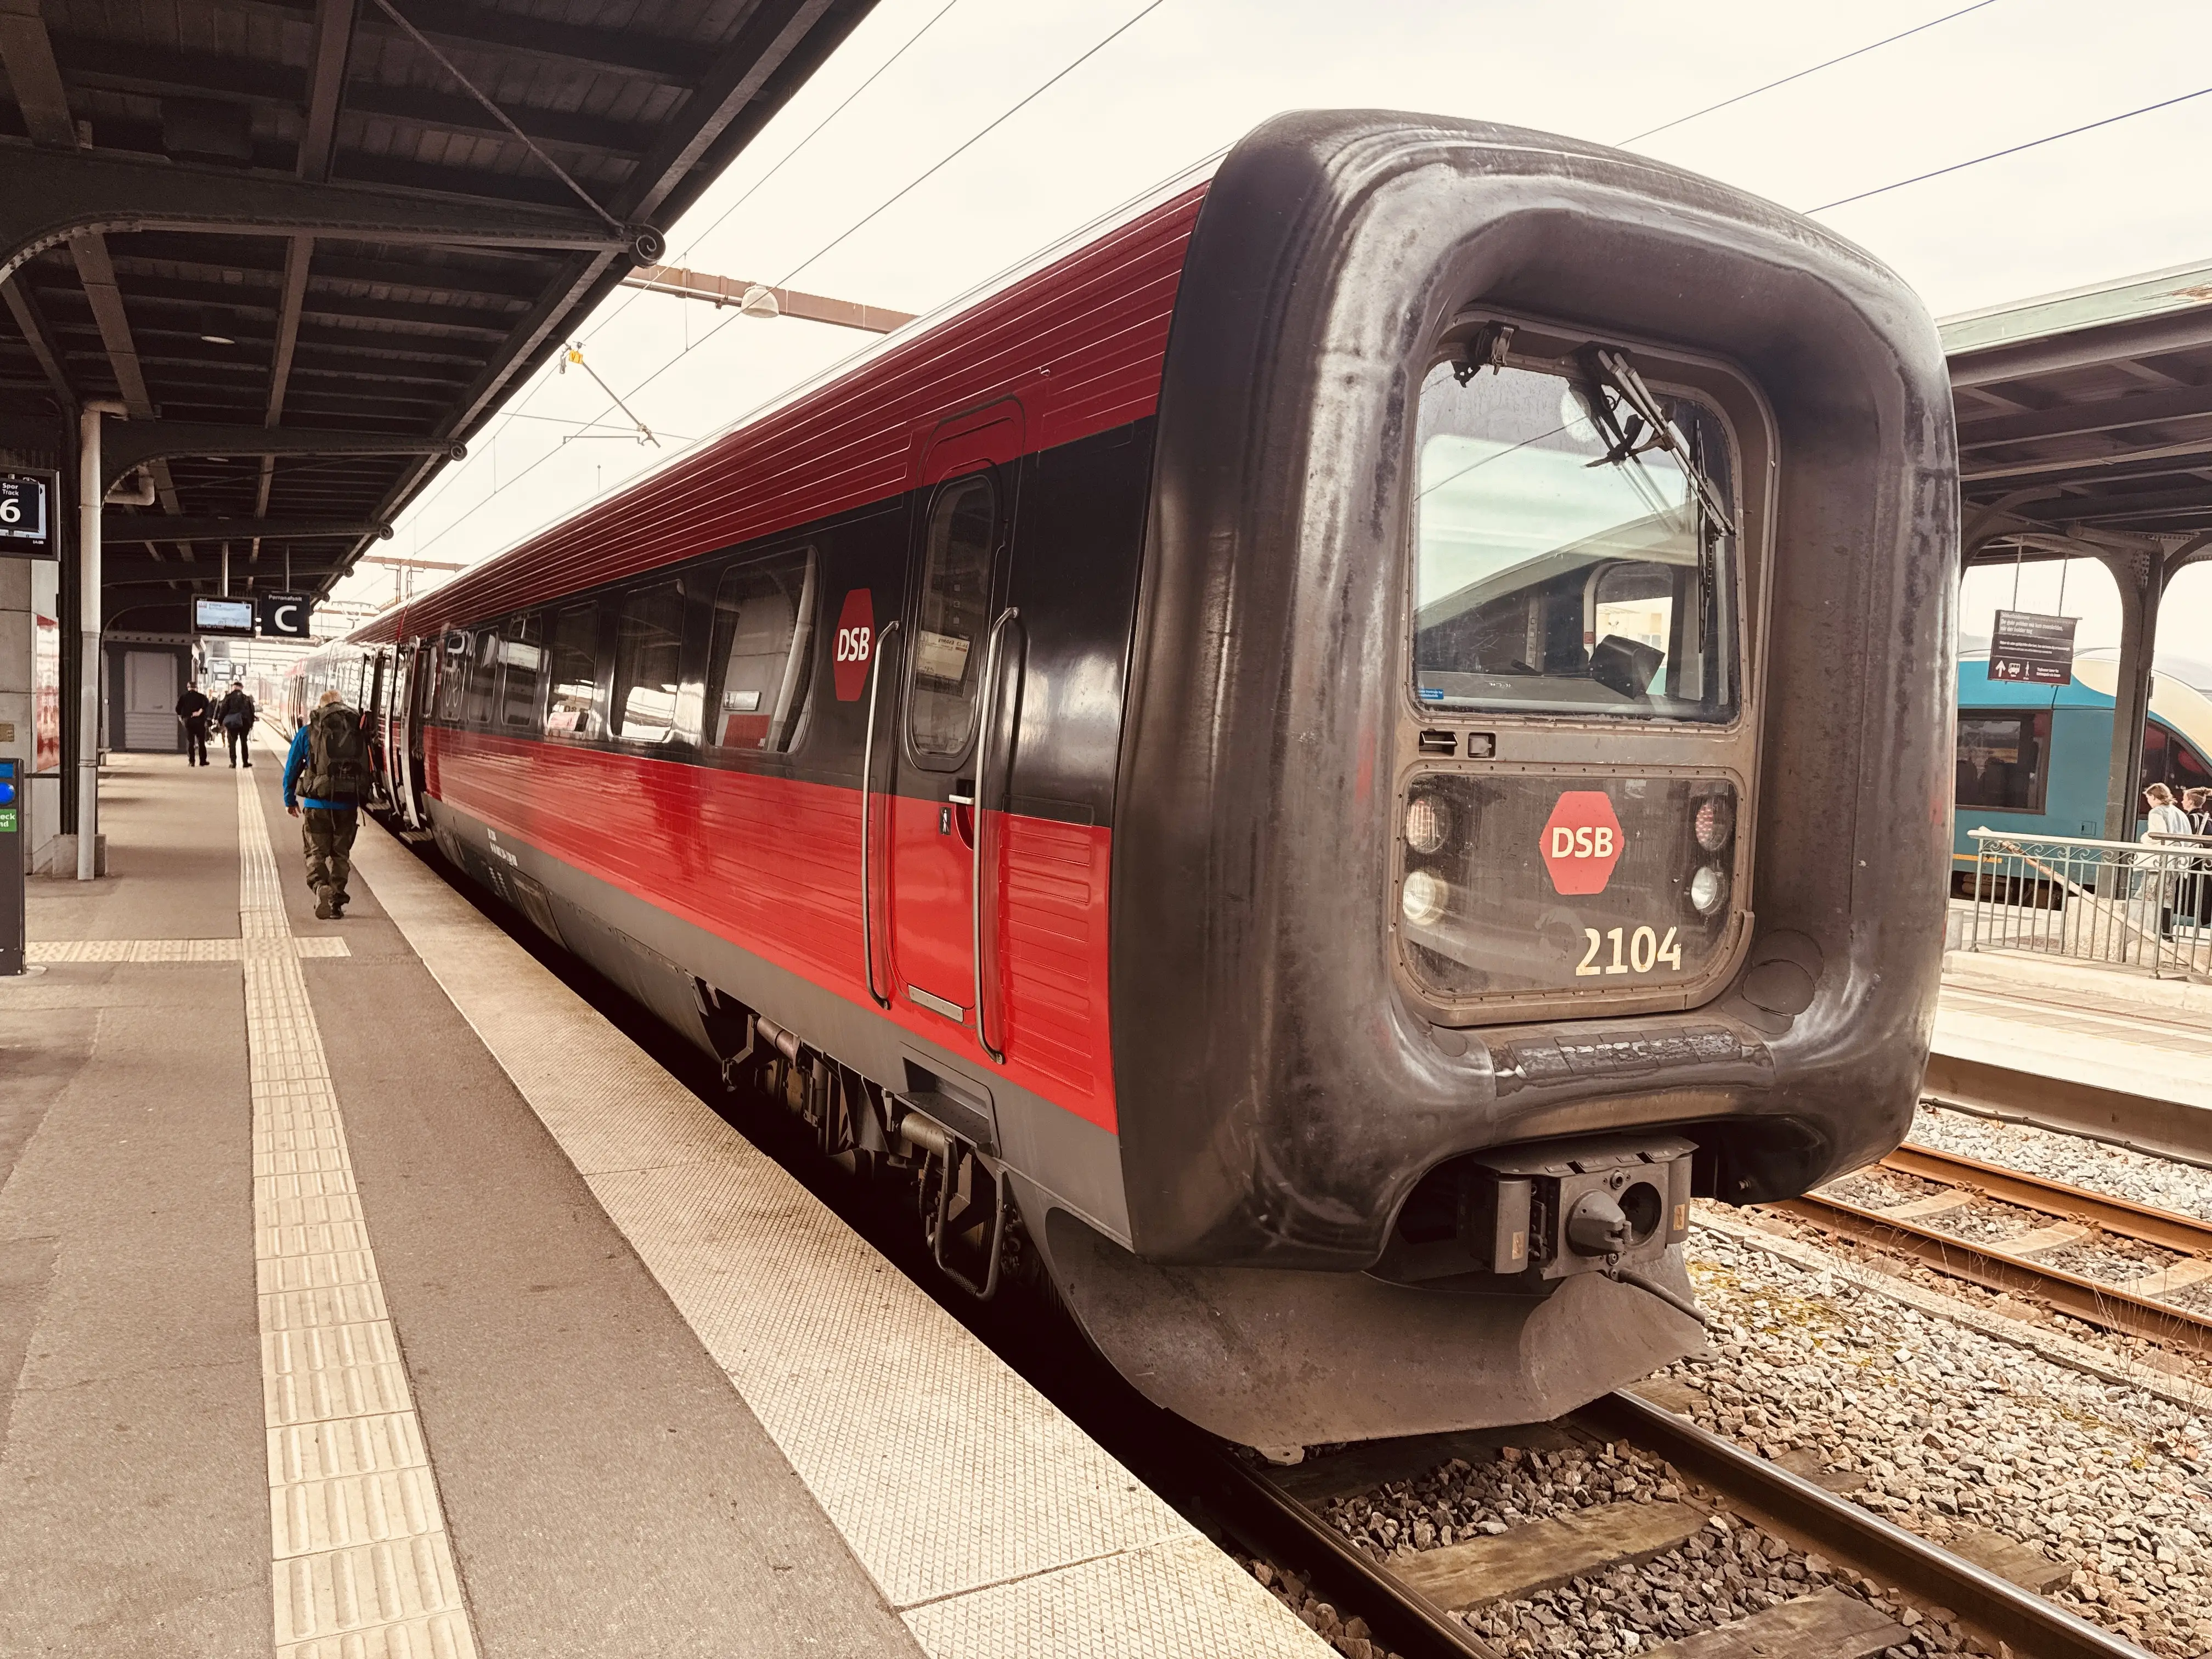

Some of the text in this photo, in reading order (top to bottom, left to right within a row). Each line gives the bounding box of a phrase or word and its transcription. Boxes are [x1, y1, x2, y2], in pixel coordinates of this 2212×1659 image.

[0, 498, 21, 523] 6
[274, 605, 298, 632] C
[837, 627, 870, 662] DSB
[1551, 827, 1613, 859] DSB
[1575, 926, 1681, 976] 2104
